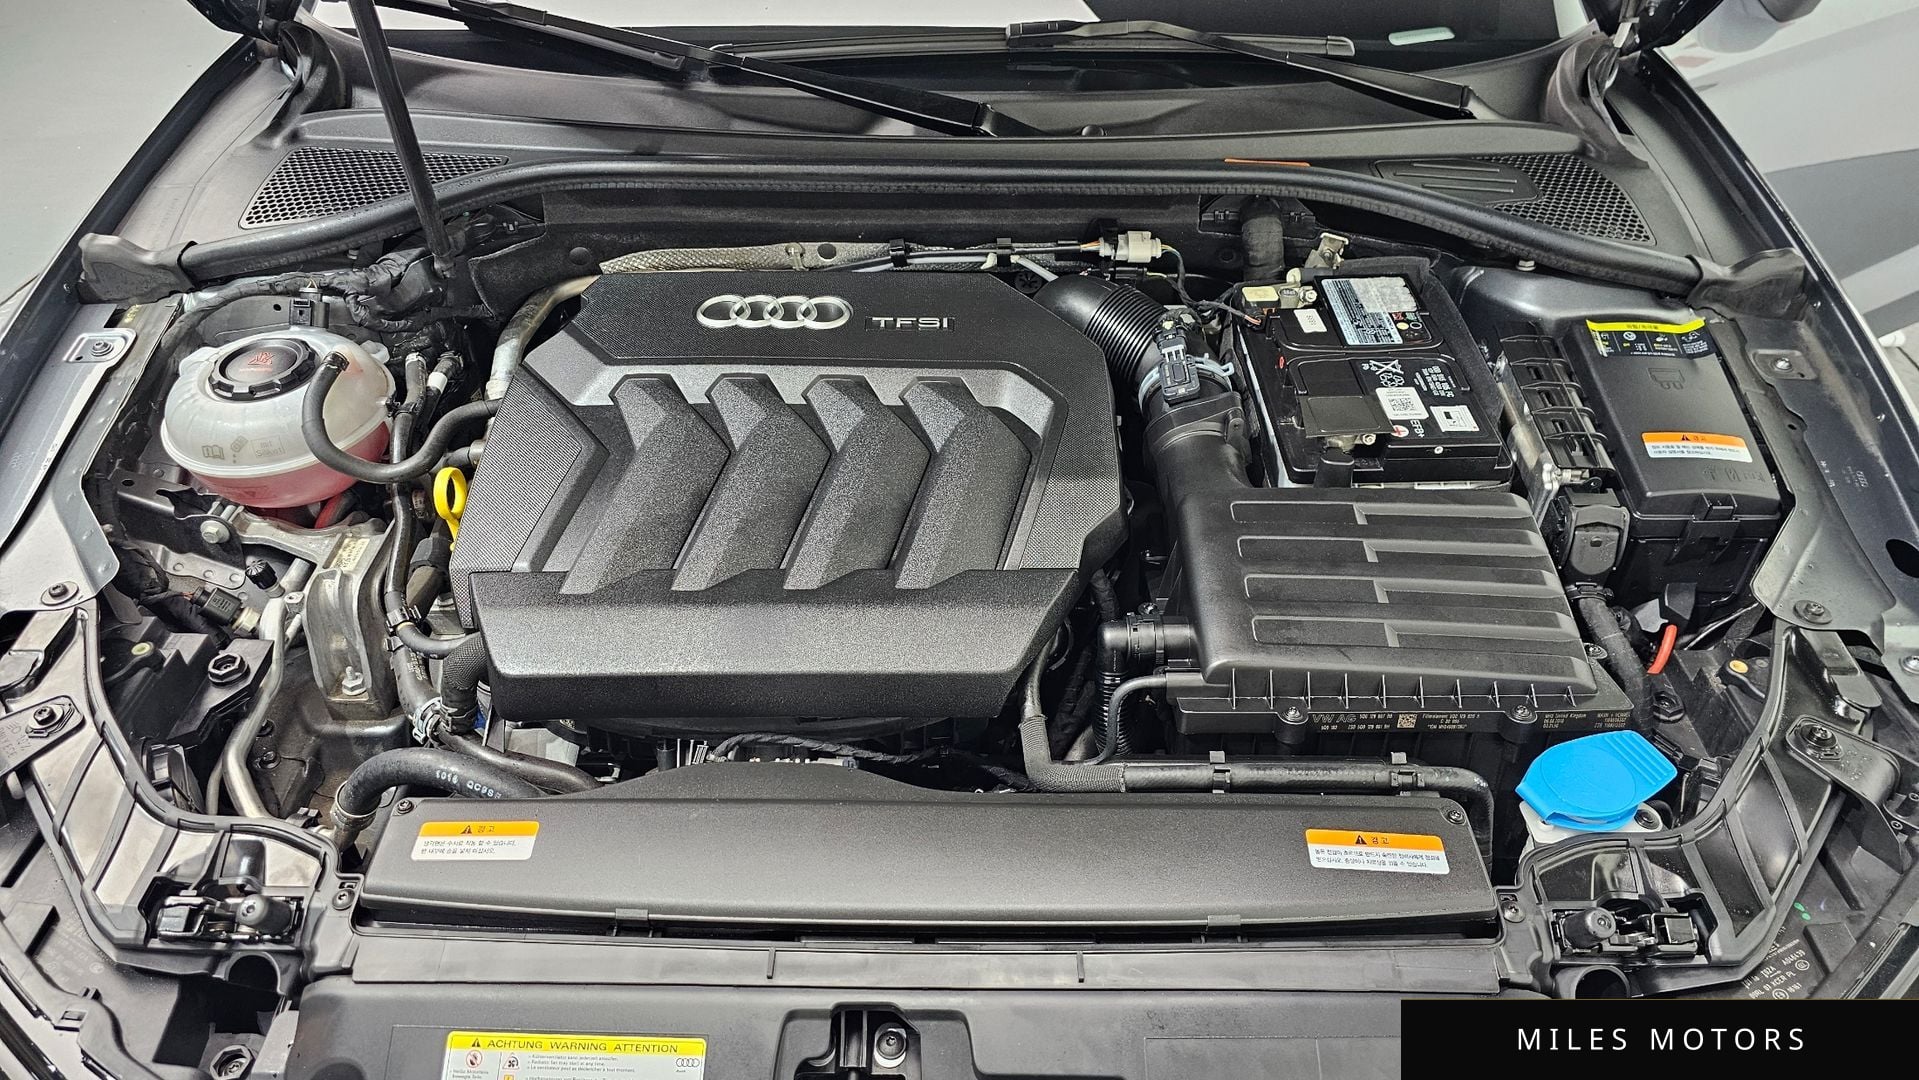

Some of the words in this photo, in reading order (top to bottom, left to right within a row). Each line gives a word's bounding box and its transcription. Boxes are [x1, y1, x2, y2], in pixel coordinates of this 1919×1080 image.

[871, 316, 948, 328] TFSI
[1312, 714, 1334, 723] VW
[1336, 714, 1357, 723] AG
[487, 1039, 543, 1050] ACHTUNG
[549, 1041, 607, 1052] WARNING
[613, 1043, 679, 1054] ATTENTION
